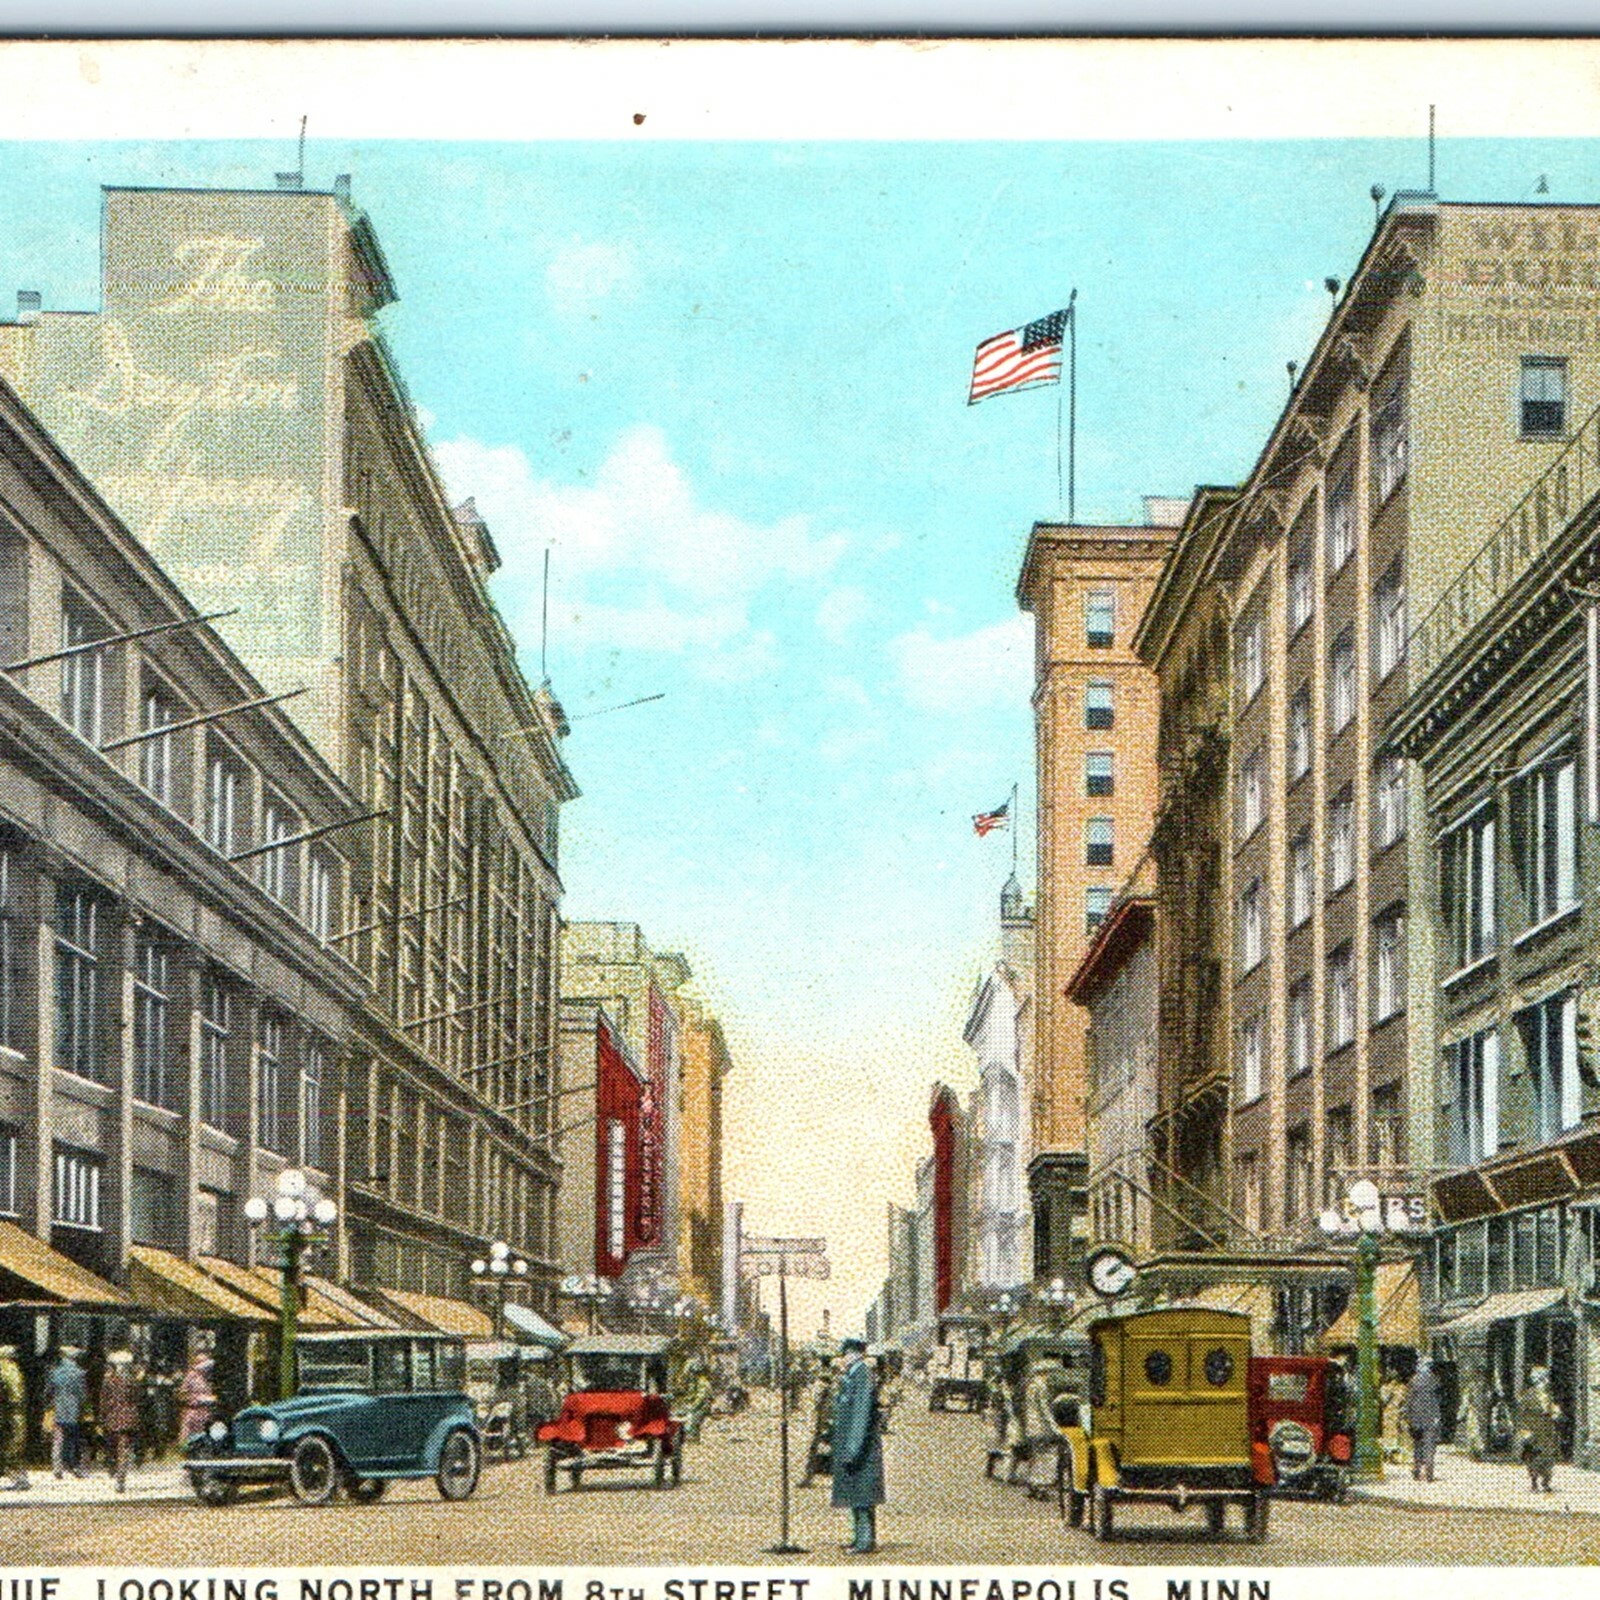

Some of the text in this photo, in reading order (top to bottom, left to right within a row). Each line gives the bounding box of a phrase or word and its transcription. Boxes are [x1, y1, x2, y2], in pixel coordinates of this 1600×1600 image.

[97, 1579, 278, 1600] LOOKING
[300, 1579, 432, 1600] NORTH
[456, 1579, 562, 1600] FROM
[664, 1579, 809, 1600] STREET
[849, 1579, 1129, 1600] MINNEAPOLIS
[1167, 1580, 1270, 1600] MINN
